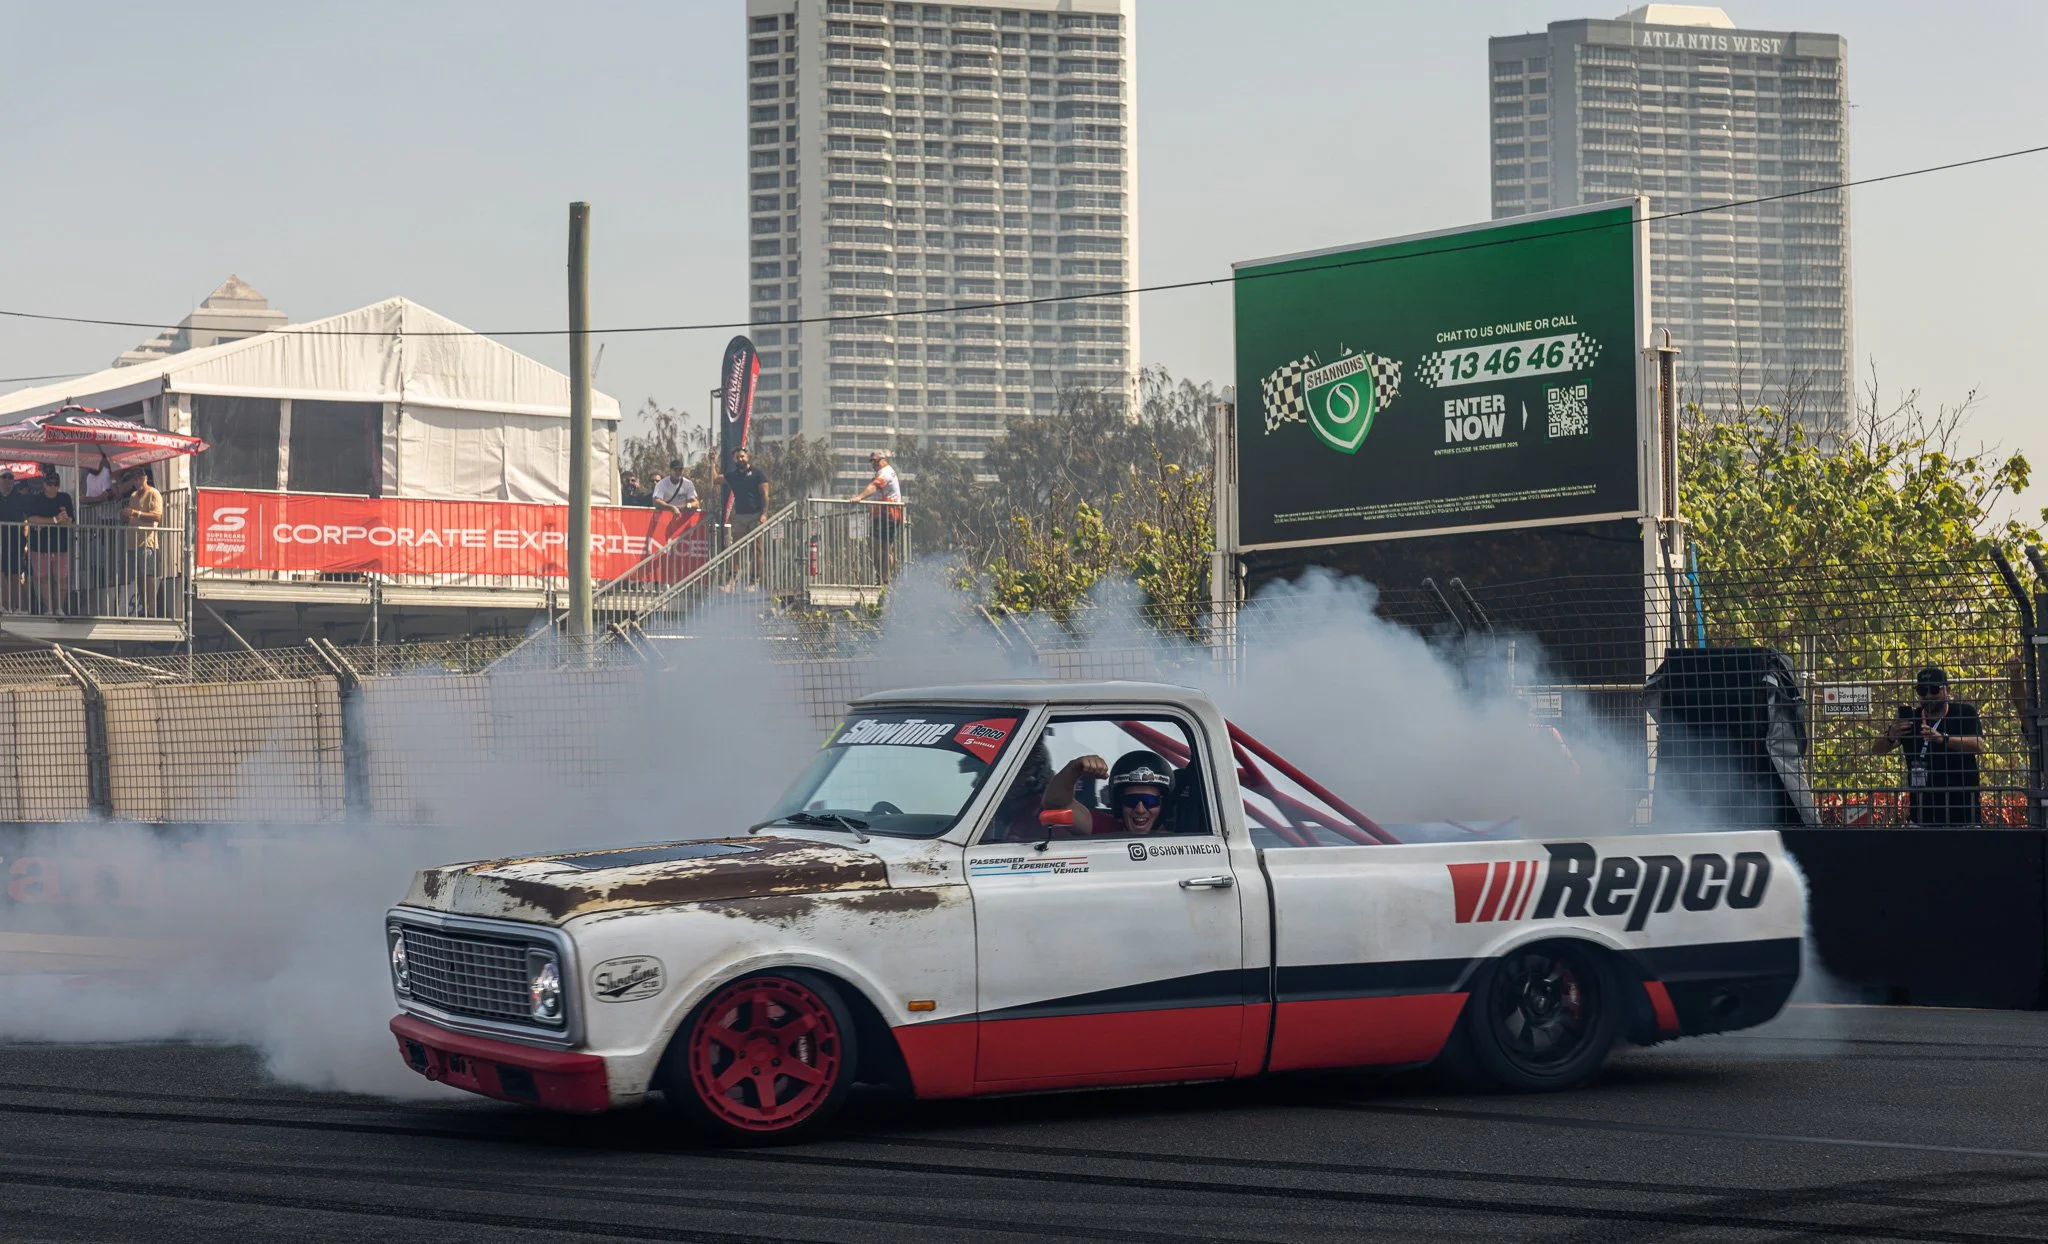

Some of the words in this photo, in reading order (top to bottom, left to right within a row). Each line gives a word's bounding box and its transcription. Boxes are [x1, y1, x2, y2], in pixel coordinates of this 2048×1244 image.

[1643, 31, 1727, 50] ATLANTIS
[1732, 36, 1781, 54] WEST
[1436, 330, 1462, 343] CHAT
[1465, 328, 1478, 339] TO
[1480, 326, 1493, 337] US
[1495, 321, 1532, 335] ONLINE
[1534, 318, 1549, 330] OR
[1551, 315, 1577, 328] CALL
[1306, 356, 1364, 389] SHANNONS
[1450, 352, 1478, 380] 13
[1484, 346, 1522, 375] 46
[1527, 341, 1566, 370] 46
[1444, 394, 1506, 418] ENTER
[1445, 412, 1506, 443] NOW
[1434, 448, 1455, 456] ENTRIES
[1456, 446, 1472, 454] CLOSE
[1479, 442, 1506, 451] DECEMBER
[272, 523, 487, 548] CORPORATE
[493, 529, 709, 558] EXPRIENCE
[837, 719, 956, 746] ShowTime
[970, 723, 1007, 741] Repco
[969, 857, 1025, 865] PASSENGER
[1148, 843, 1221, 857] @SHOWTIMEC10
[1010, 861, 1067, 870] EXPERIENCE
[1053, 866, 1090, 874] VEHICLE
[1532, 842, 1771, 932] Repco
